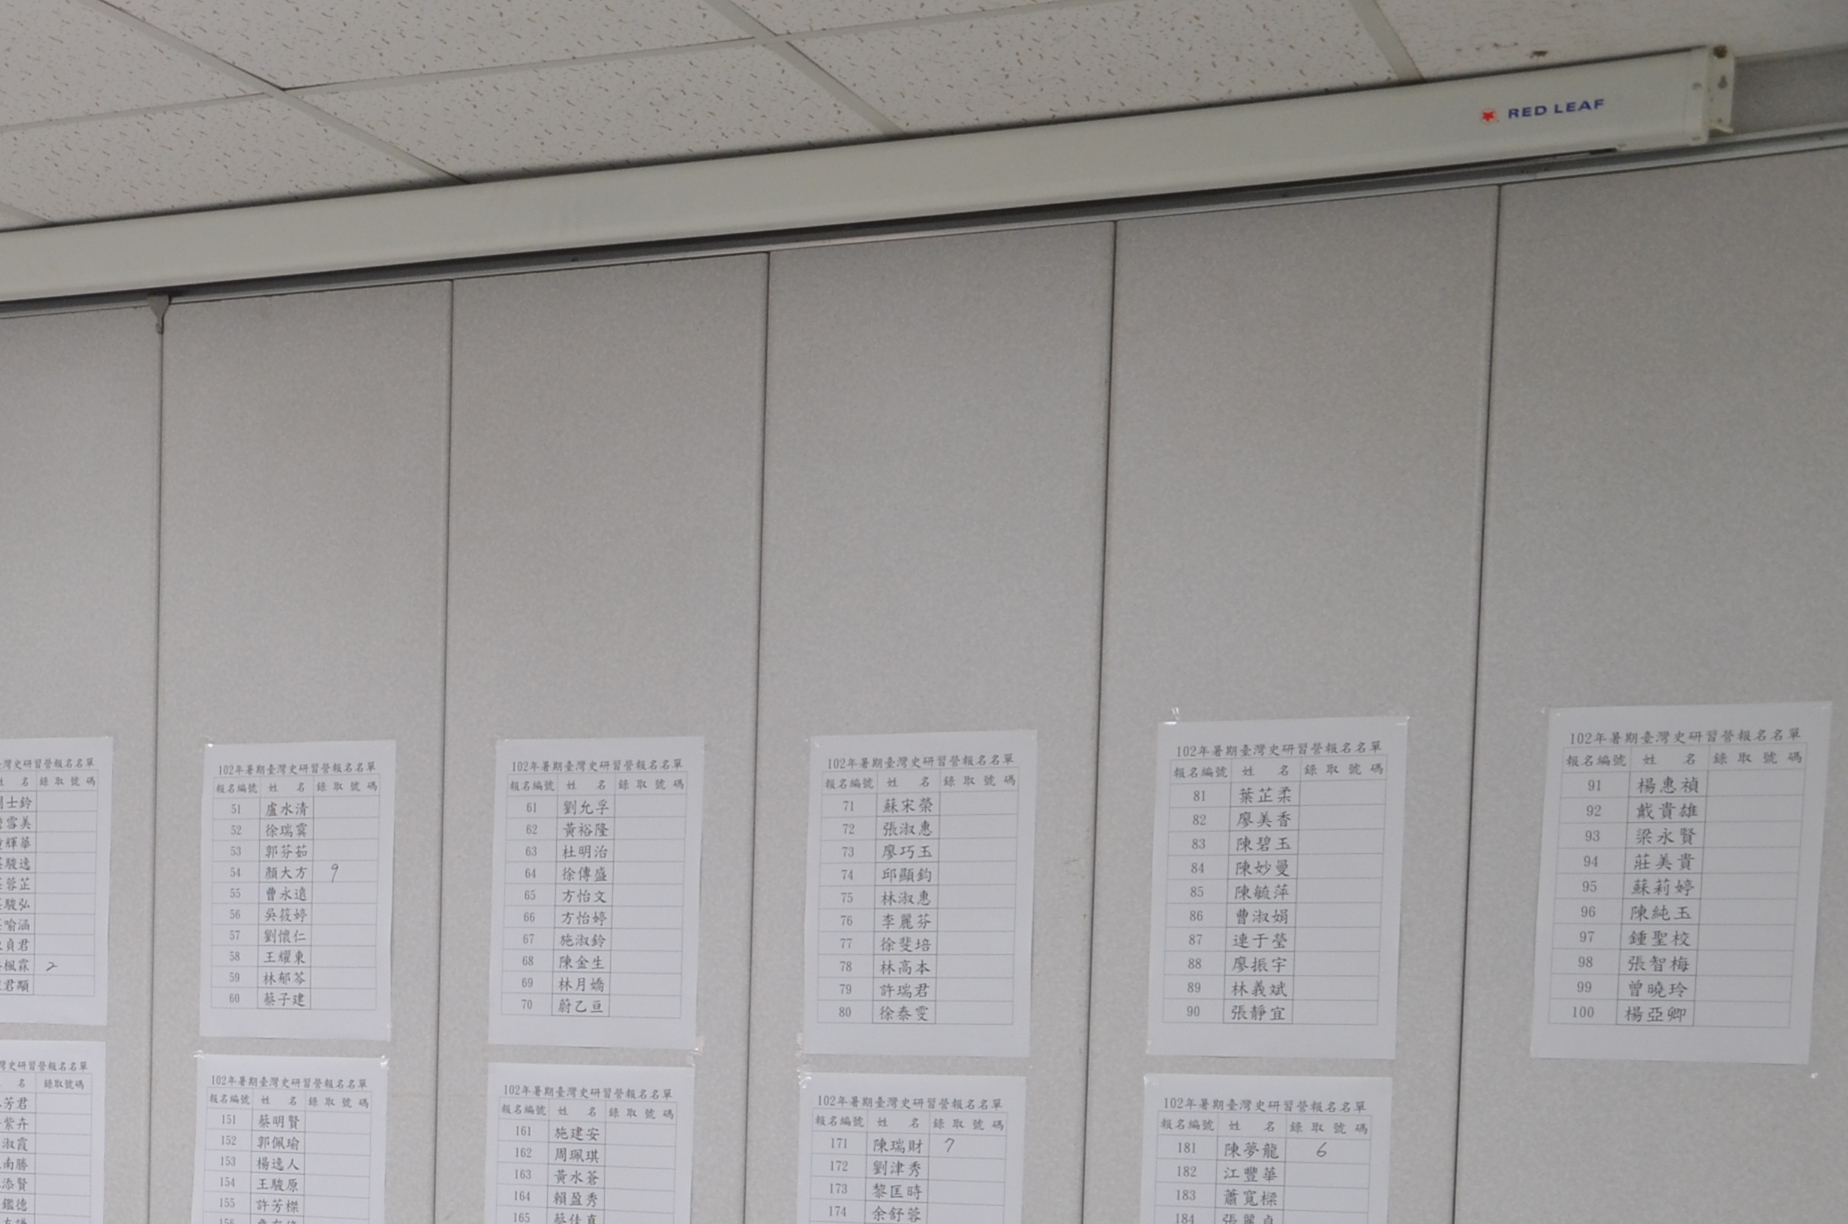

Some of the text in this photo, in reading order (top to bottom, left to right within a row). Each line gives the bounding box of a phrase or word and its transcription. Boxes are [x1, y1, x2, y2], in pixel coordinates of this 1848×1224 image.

[1508, 99, 1605, 119] RED LEAF
[1569, 727, 1802, 745] 102年暑期臺灣史研習營報名名單
[1176, 740, 1382, 757] 102年暑期臺灣史研習營報名名單
[511, 759, 684, 772] 102年暑期臺灣史研習營報名名單
[827, 753, 1014, 769] 102年暑期臺灣史研習營報名名單
[218, 763, 377, 776] 102年暑期臺灣史研習營報名名單
[1587, 779, 1602, 791] 91
[1192, 786, 1292, 803] 81 葉芷柔
[842, 800, 855, 812] 71
[1585, 802, 1698, 820] 92 戴貴雄
[1191, 811, 1292, 827] 82 廖美香
[842, 820, 933, 836] 72 張淑惠
[1191, 836, 1291, 852] 83 陳碧玉
[1584, 828, 1697, 845] 93 梁永賢
[524, 845, 609, 859] 63 杜明治
[841, 844, 933, 860] 73 廖巧玉
[1190, 859, 1290, 877] 84 陳妙曼
[1583, 853, 1695, 870] 94 莊美貴
[229, 866, 308, 879] 54 顏大方
[330, 863, 339, 883] 9
[841, 868, 933, 882] 74 邱顯鈞
[1189, 884, 1289, 900] 85 陳毓萍
[1581, 878, 1695, 896] 95 蘇莉婷
[523, 889, 607, 903] 65 方怡文
[840, 890, 931, 906] 75 林淑惠
[522, 911, 608, 926] 66 方怡婷
[1188, 908, 1289, 924] 86 曹淑娟
[1580, 904, 1692, 921] 96 陳純玉
[839, 913, 932, 929] 76 李麗芬
[839, 938, 854, 949] 77
[1188, 933, 1288, 949] 87 連于瑩
[1578, 931, 1596, 943] 97
[521, 955, 605, 969] 68 陳金生
[839, 960, 931, 975] 78 林高本
[1187, 956, 1288, 973] 88 廖振宇
[1577, 955, 1690, 972] 98 張智梅
[838, 983, 930, 998] 79 許瑞君
[1186, 980, 1288, 997] 89 林義斌
[1576, 980, 1689, 998] 99 曾曉玲
[838, 1006, 929, 1021] 80 徐泰雯
[1186, 1005, 1286, 1021] 90 張靜宜
[1572, 1006, 1687, 1022] 100 楊亞卿
[210, 1075, 368, 1090] 102年暑期臺灣史研習營報名名單
[503, 1085, 673, 1100] 102年暑期臺灣史研習營報名名單
[817, 1095, 1004, 1110] 102年暑期臺灣史研習營報名名單
[1163, 1097, 1367, 1113] 102年暑期臺灣史研習營報名名單
[515, 1126, 600, 1141] 161 施建安
[830, 1137, 923, 1153] 171 陳瑞財
[944, 1138, 955, 1153] 7
[1177, 1142, 1280, 1159] 181 陳夢龍
[1316, 1142, 1328, 1157] 6
[830, 1160, 921, 1177] 172 劉津秀
[1177, 1166, 1278, 1182] 182 江豐華
[829, 1183, 922, 1200] 173 黎匡時
[1176, 1189, 1197, 1200] 183
[828, 1205, 922, 1222] 174 余舒蓉
[1175, 1213, 1195, 1224] 184
